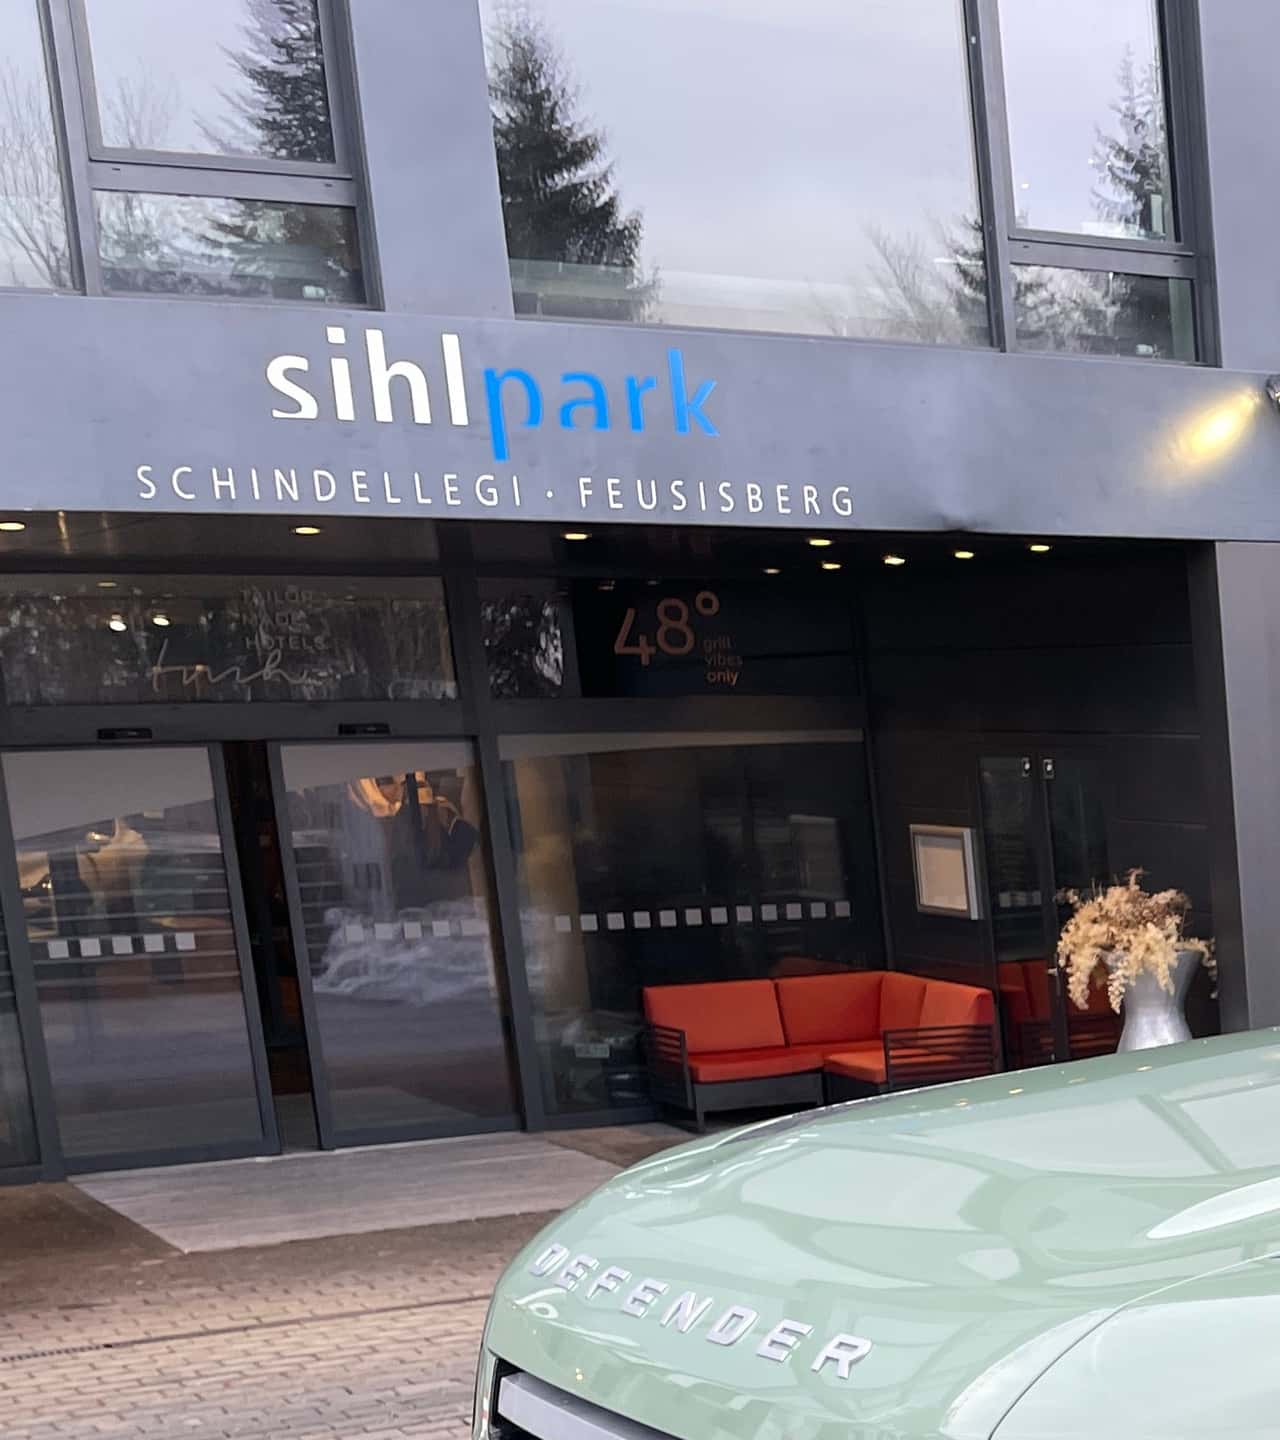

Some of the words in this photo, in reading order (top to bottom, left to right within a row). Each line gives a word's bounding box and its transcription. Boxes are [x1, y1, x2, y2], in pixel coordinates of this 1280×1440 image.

[264, 325, 721, 462] sihlpark
[136, 463, 522, 508] SCHINDELLEGI
[579, 475, 855, 518] FEUSISBERG
[706, 669, 740, 686] only
[528, 1242, 873, 1380] DEFENDER
